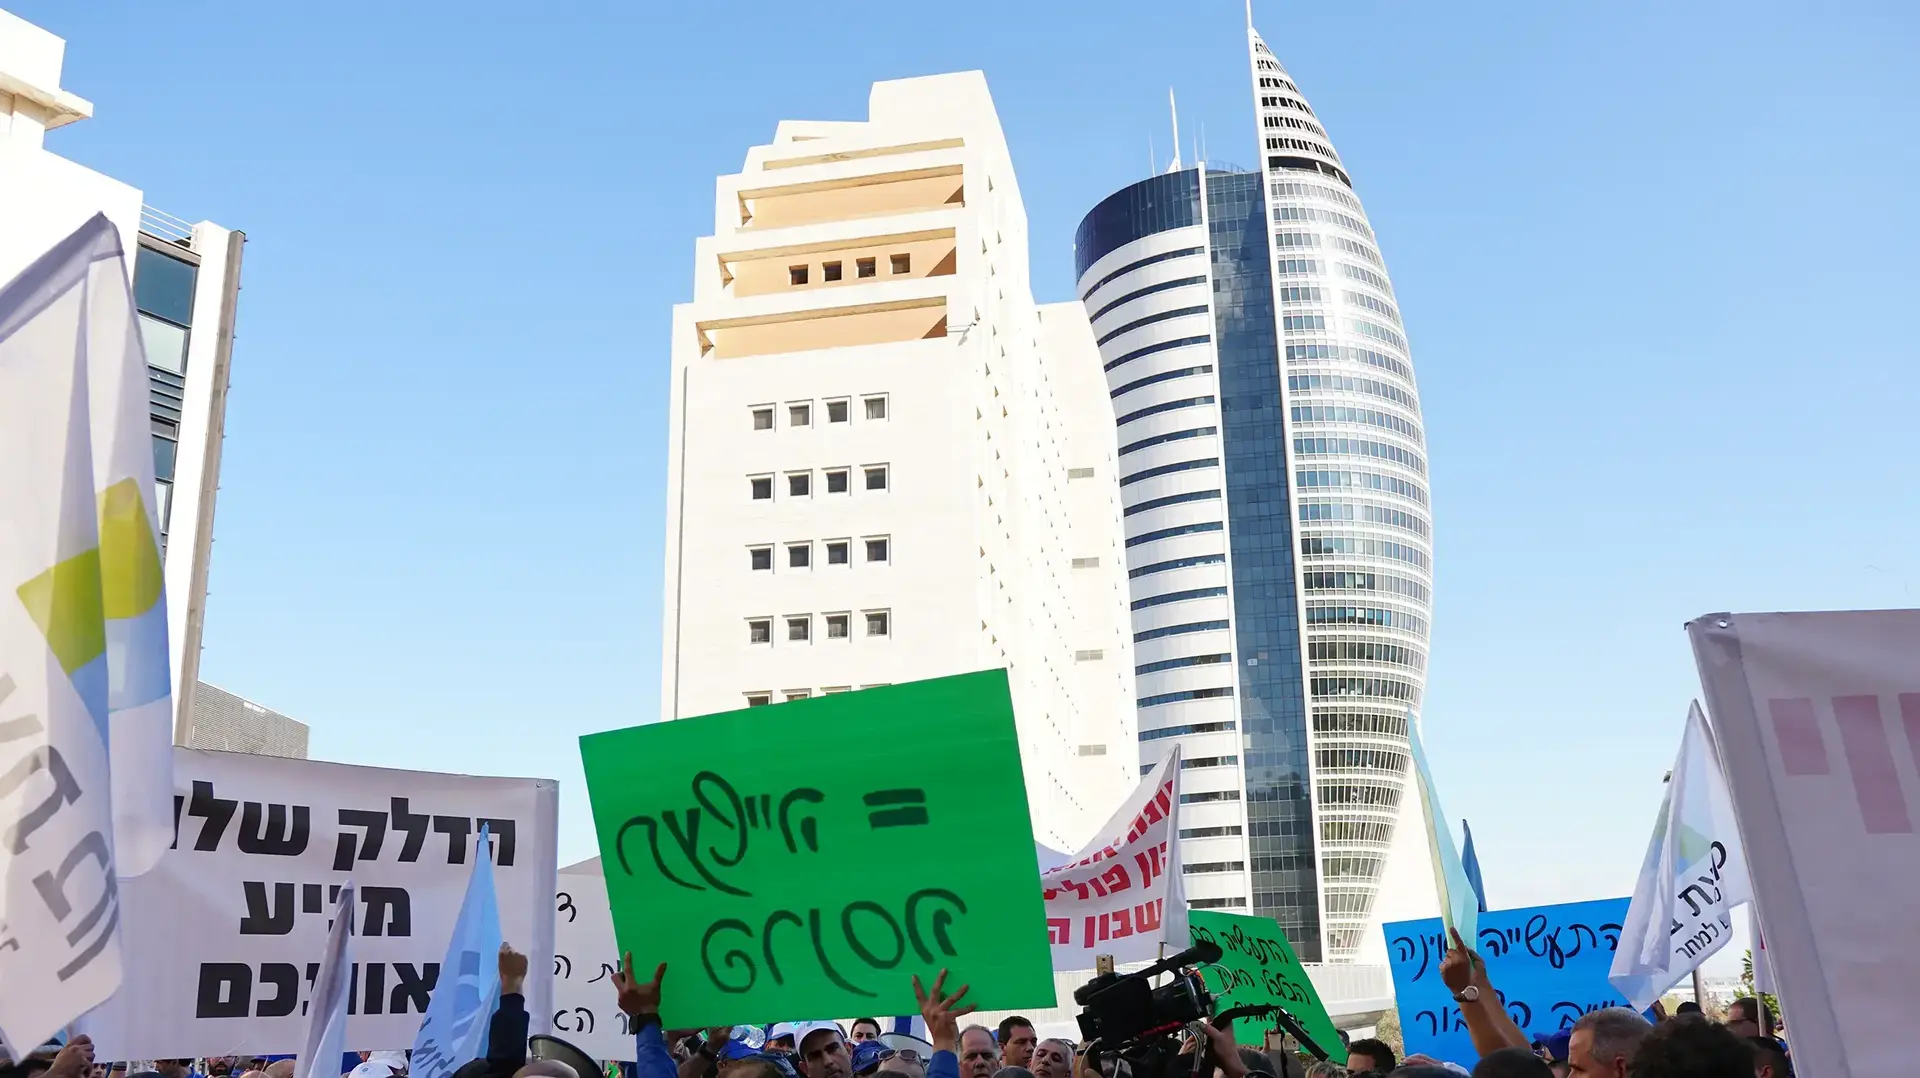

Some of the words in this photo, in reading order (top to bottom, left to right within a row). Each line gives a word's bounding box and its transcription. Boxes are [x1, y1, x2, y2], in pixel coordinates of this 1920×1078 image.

[333, 797, 516, 872] הדלק
[1084, 898, 1163, 948] שבון
[1220, 924, 1289, 966] התעשייה
[1479, 914, 1622, 969] התעשייה
[1675, 922, 1720, 959] למחר
[1260, 969, 1310, 1005] הכלכלי
